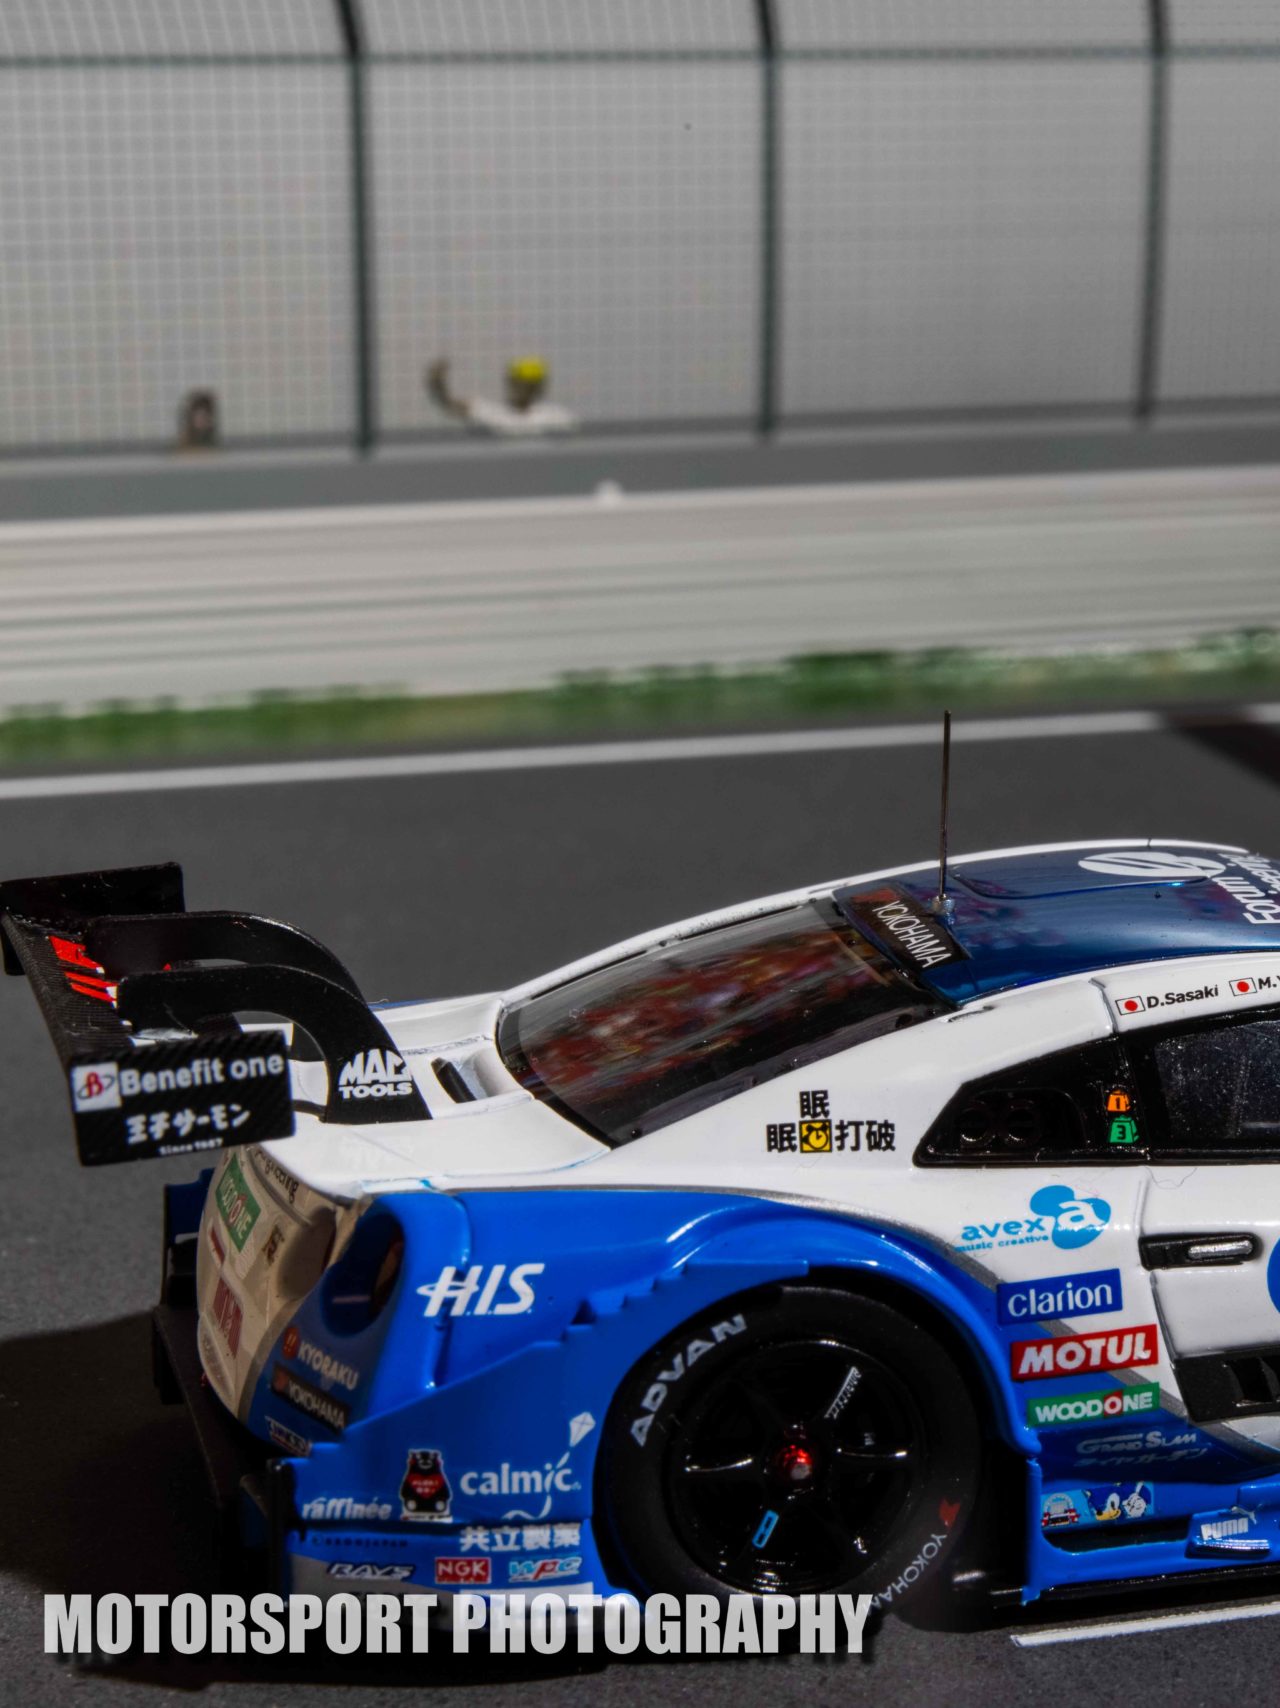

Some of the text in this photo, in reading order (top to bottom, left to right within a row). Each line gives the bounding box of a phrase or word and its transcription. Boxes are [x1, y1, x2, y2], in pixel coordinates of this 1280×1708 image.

[872, 900, 952, 968] YOKOHAMA
[1147, 984, 1218, 1009] D.Sasaki
[120, 1054, 284, 1096] Benefit one
[339, 1048, 412, 1085] MAC
[339, 1082, 413, 1099] TOOLS
[799, 1090, 830, 1118] 眠
[766, 1122, 797, 1152] 眠
[961, 1217, 1045, 1240] avex
[998, 1234, 1049, 1247] creative
[298, 1341, 359, 1391] KYORAKU
[1018, 1332, 1152, 1374] MOTUL
[630, 1313, 748, 1446] ADVAN
[288, 1379, 345, 1428] YOKOHAMA
[1035, 1392, 1153, 1423] WOODONE
[1200, 1518, 1249, 1541] PUMA
[329, 1562, 414, 1580] RAYS
[437, 1560, 487, 1576] NGK
